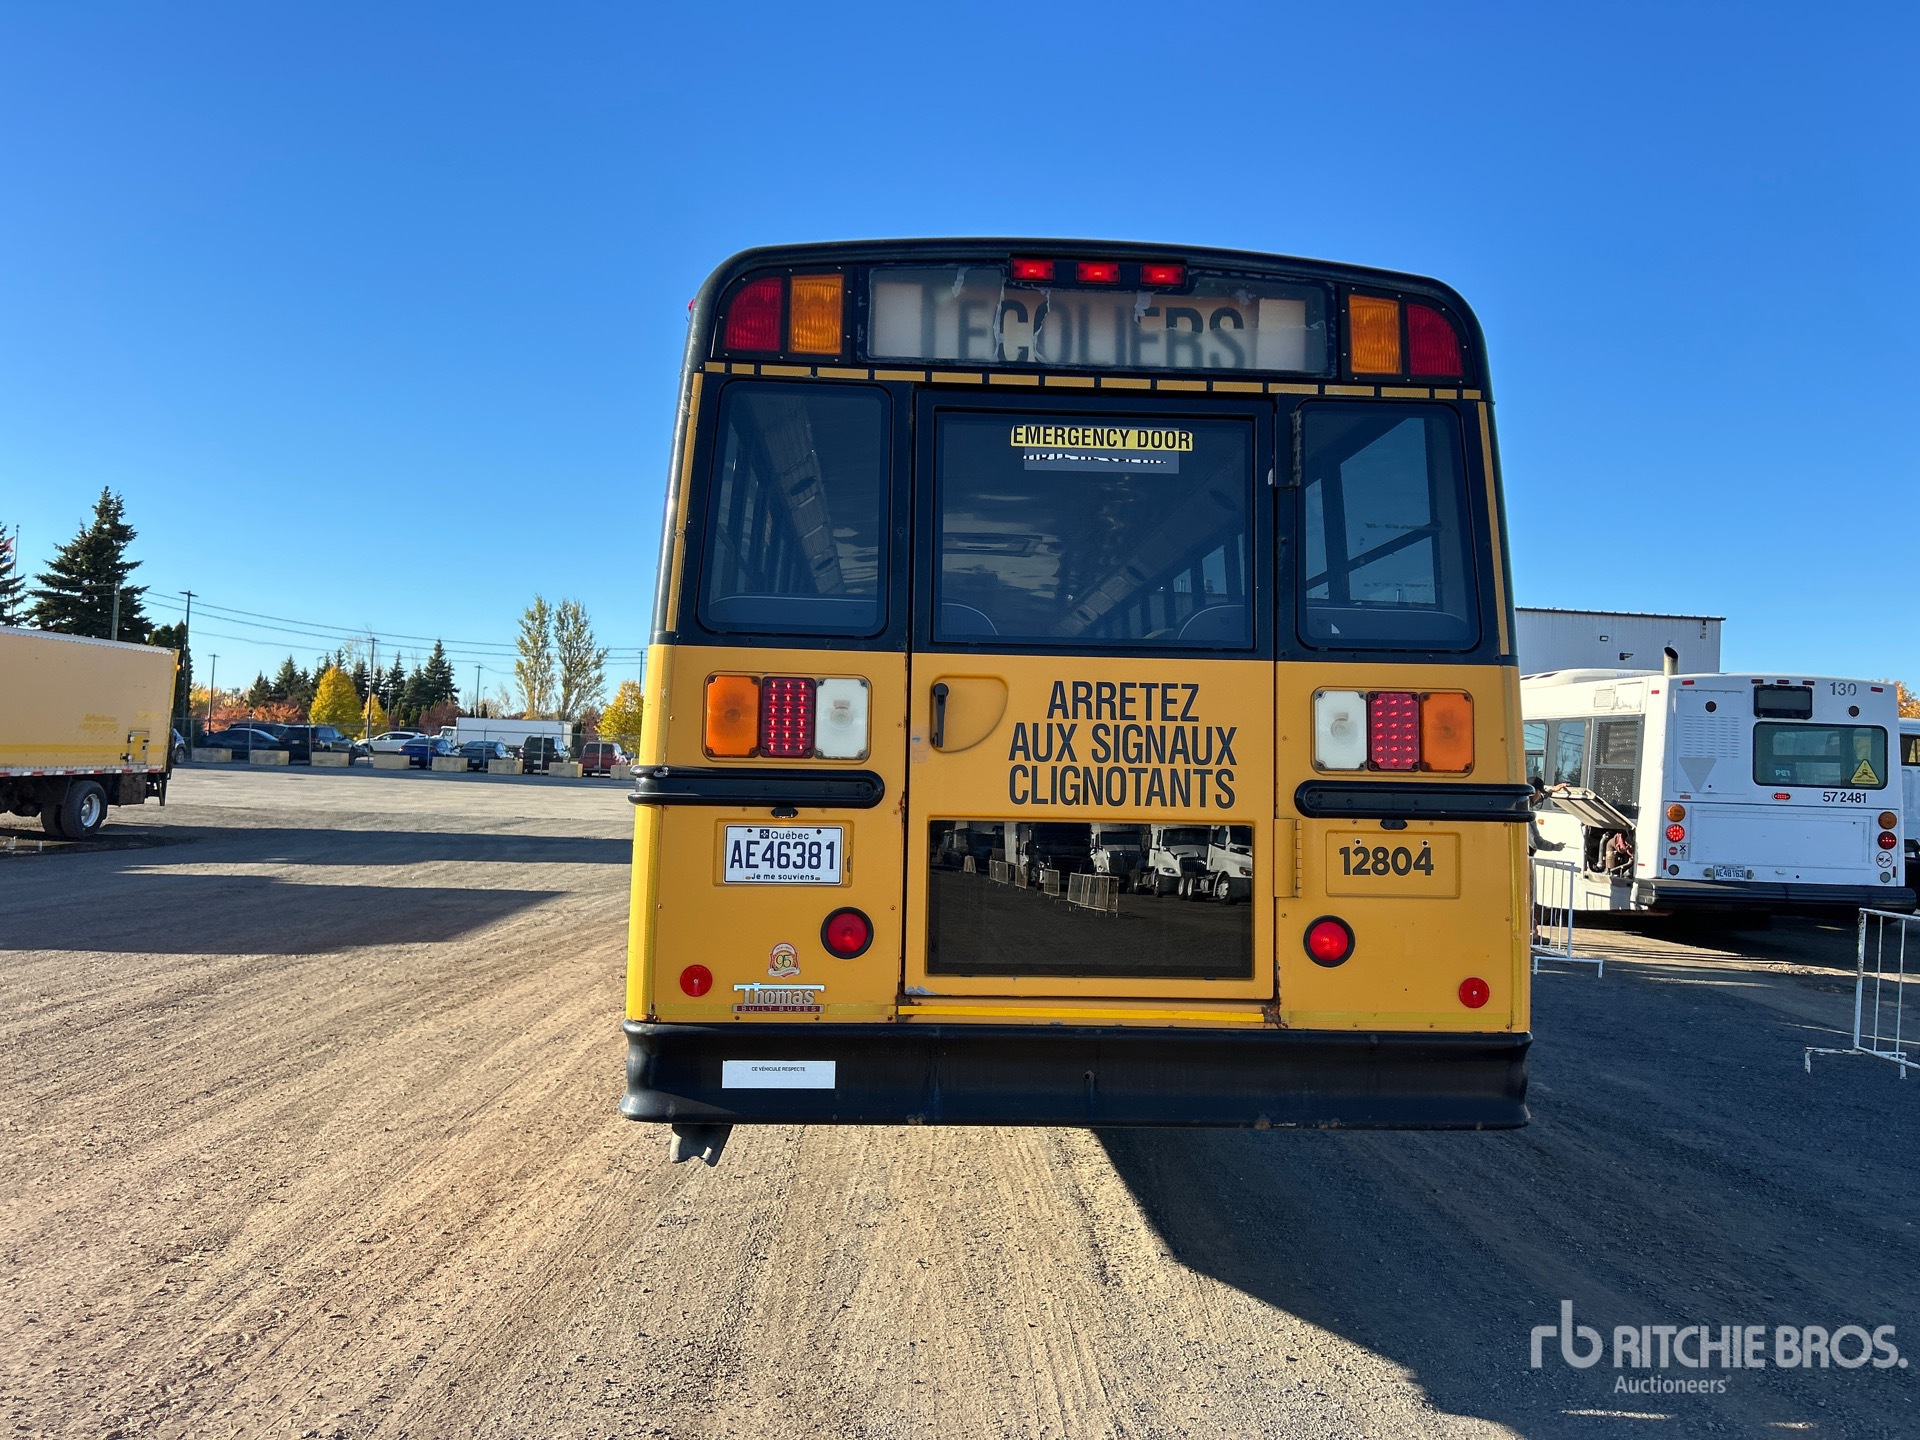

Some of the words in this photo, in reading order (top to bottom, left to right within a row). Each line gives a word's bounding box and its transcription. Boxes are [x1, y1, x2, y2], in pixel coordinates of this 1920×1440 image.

[1013, 426, 1130, 447] EMERGENCY
[1137, 430, 1190, 449] DOOR
[1047, 681, 1199, 722] ARRETEZ
[1830, 682, 1857, 696] 130
[1008, 722, 1078, 762] AUX
[1091, 723, 1237, 766] SIGNAUX
[1009, 764, 1236, 809] CLIGNOTANTS
[771, 831, 809, 840] Québec
[730, 840, 834, 869] AE46381
[1339, 846, 1434, 876] 12804
[744, 983, 815, 1005] Thomas
